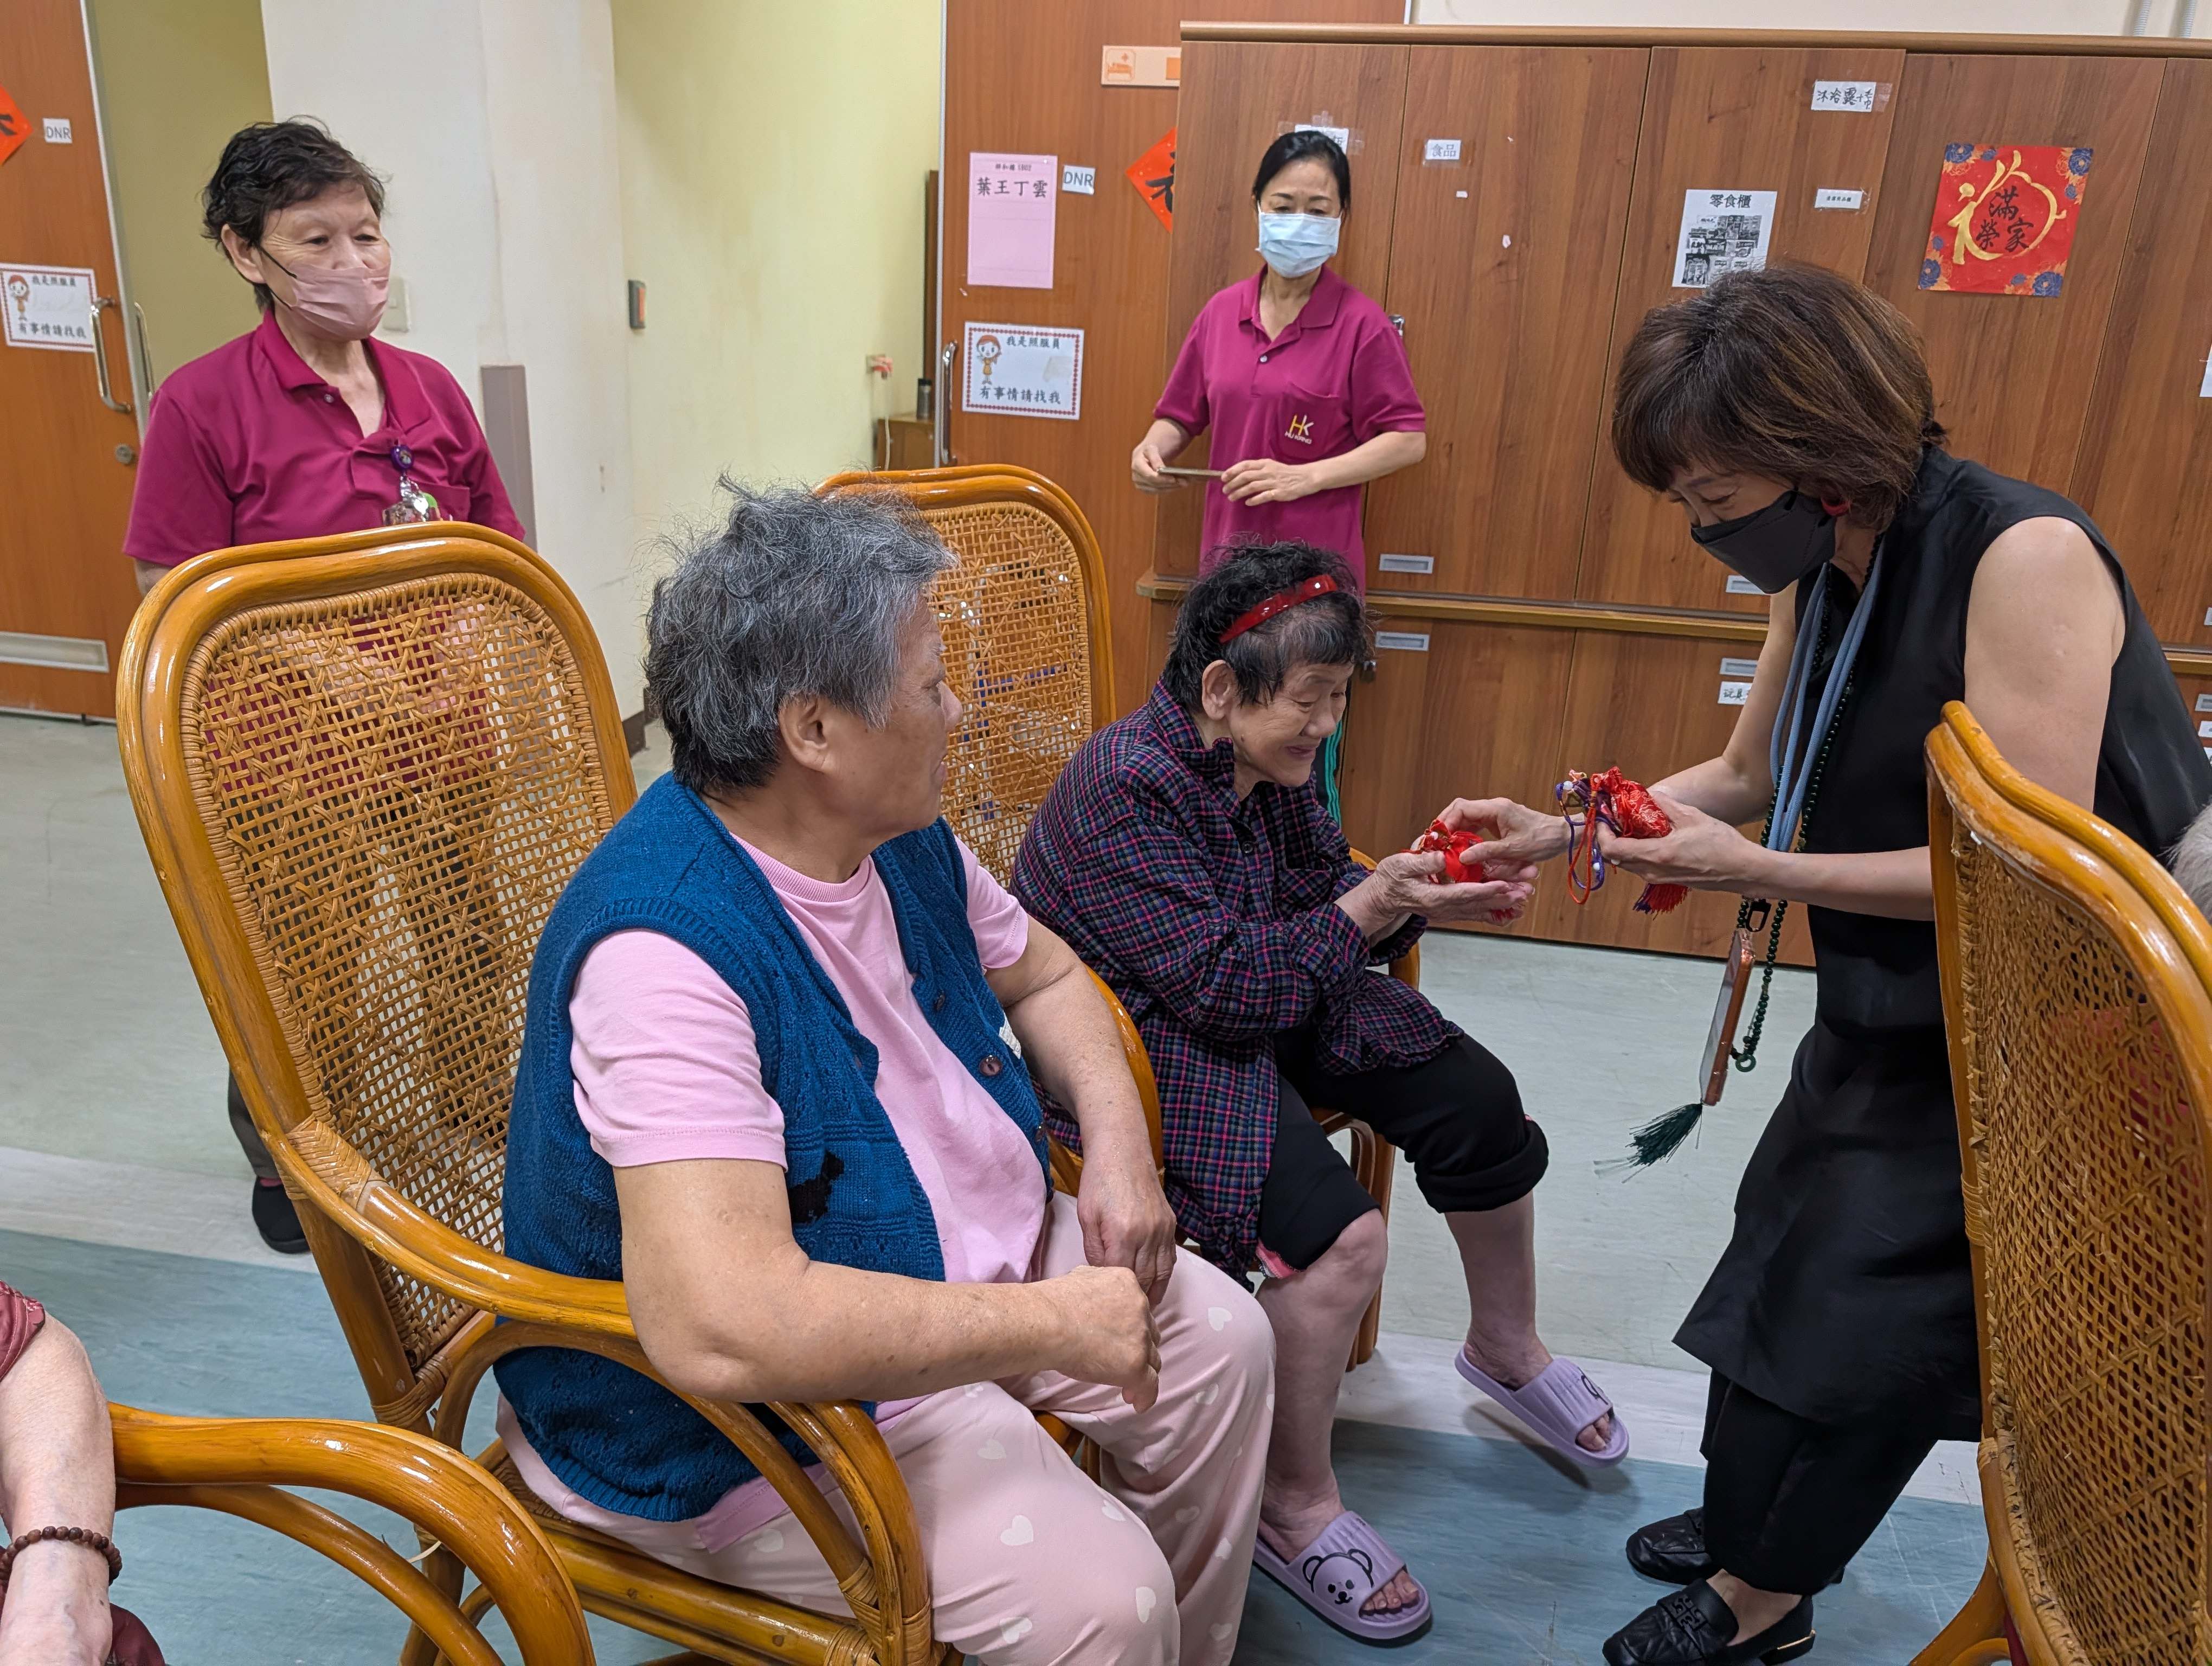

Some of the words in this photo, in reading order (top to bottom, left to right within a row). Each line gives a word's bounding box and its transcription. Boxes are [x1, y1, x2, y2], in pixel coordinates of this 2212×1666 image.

[47, 125, 71, 139] DNR
[1432, 143, 1457, 157] 食品
[1064, 171, 1094, 187] DNR
[976, 176, 1048, 198] 葉王丁雲
[1709, 194, 1752, 209] 零食櫃
[1006, 335, 1060, 350] 我是照服員
[979, 386, 1061, 405] 有事情請找我
[1289, 414, 1314, 436] HK
